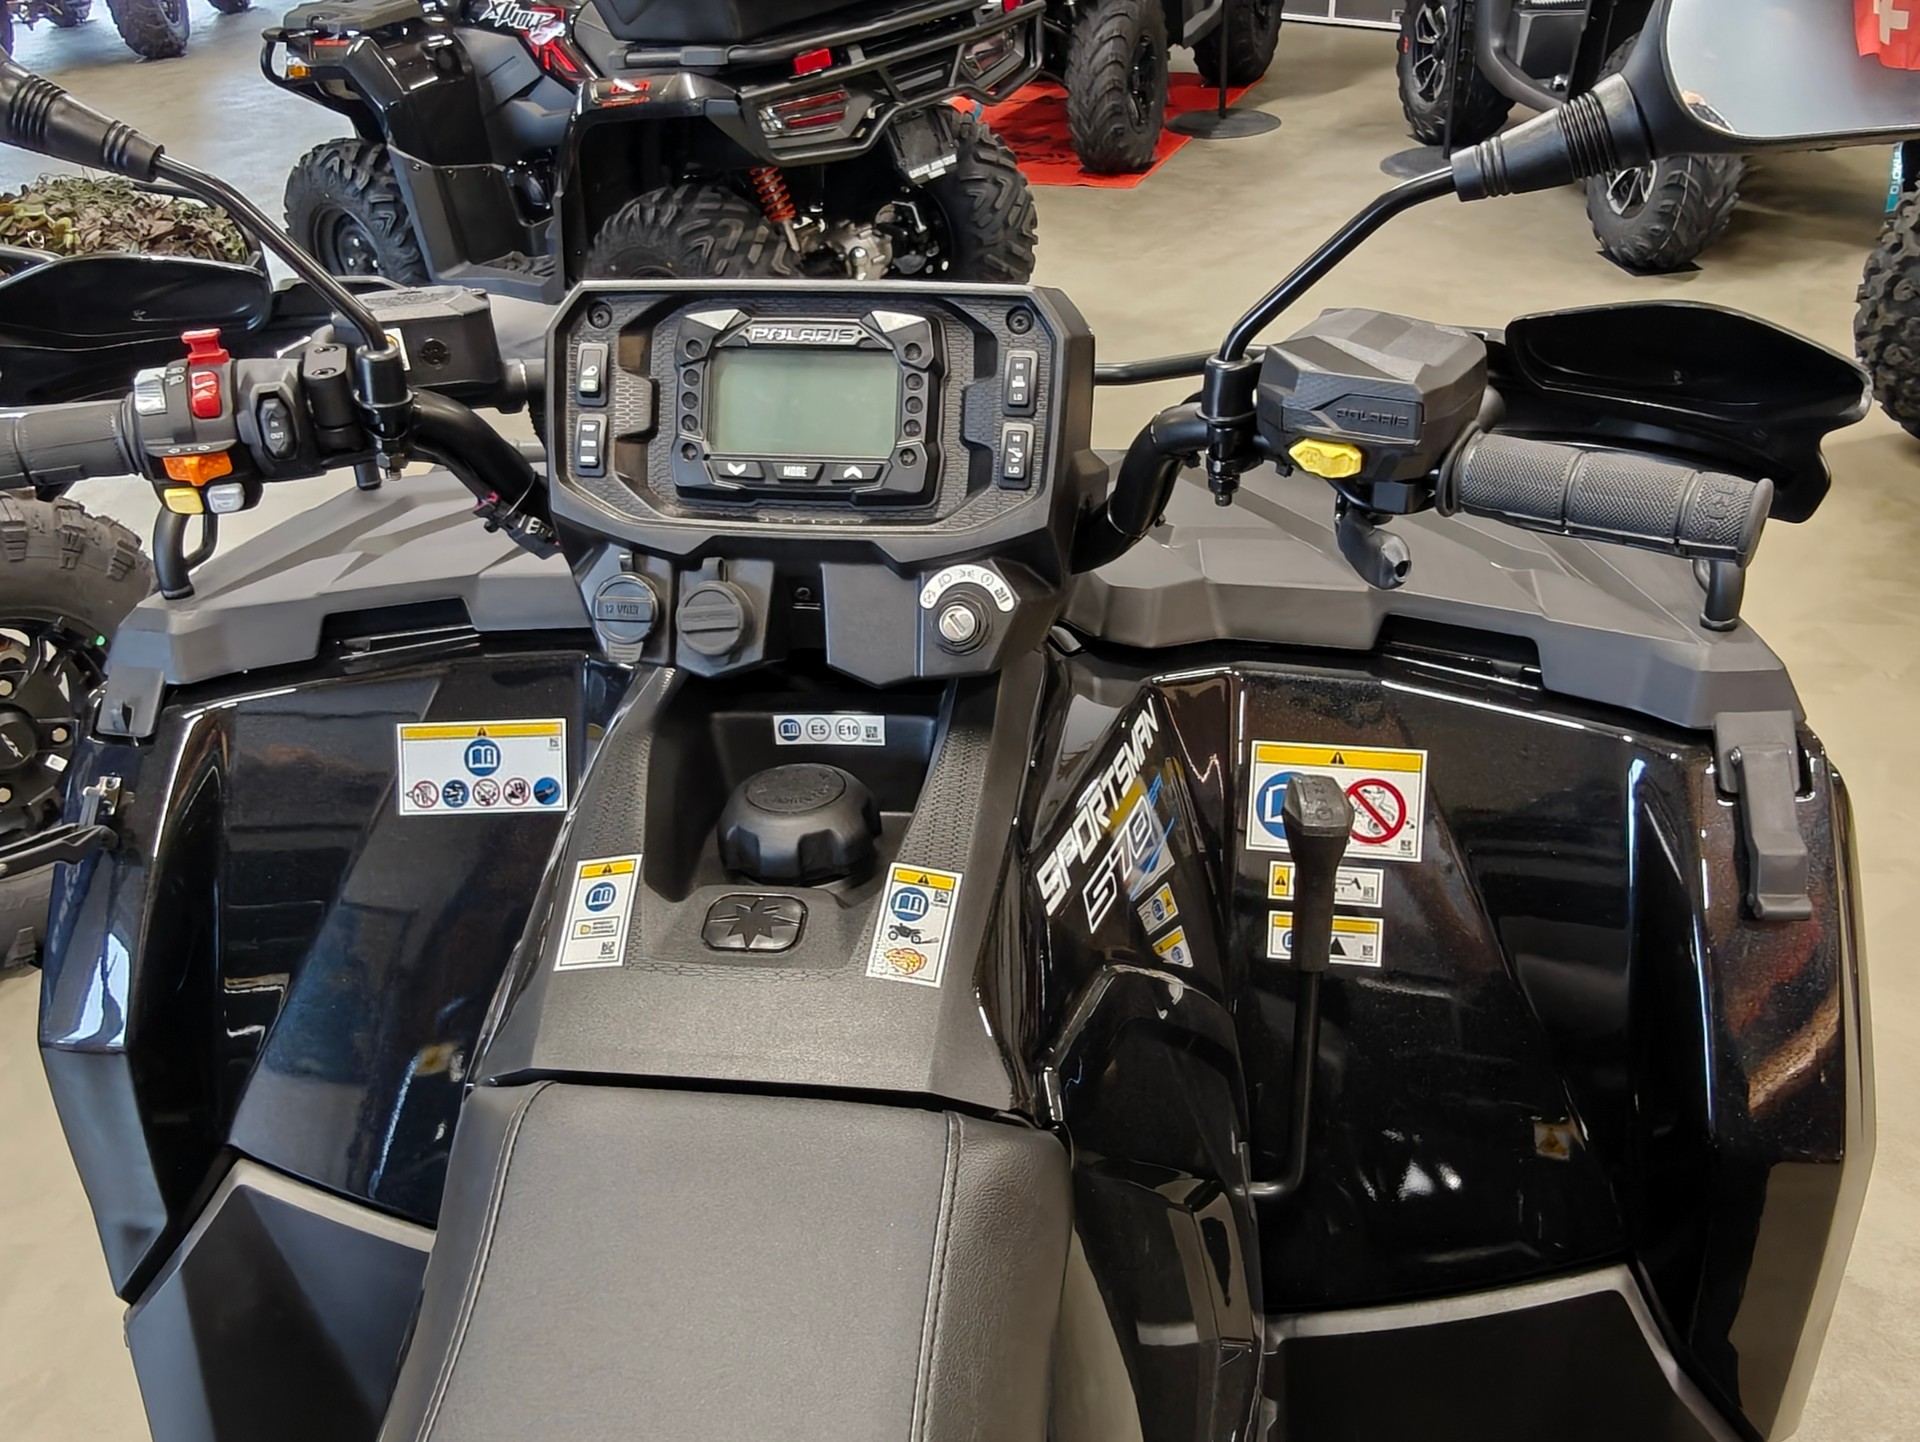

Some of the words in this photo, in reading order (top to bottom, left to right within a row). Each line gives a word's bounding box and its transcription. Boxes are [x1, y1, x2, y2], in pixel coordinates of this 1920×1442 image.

[750, 327, 856, 343] POLARIS
[1013, 393, 1023, 401] LO
[1336, 407, 1409, 427] POLARIS
[270, 432, 284, 440] OUT
[783, 465, 808, 478] MODE
[1008, 466, 1020, 474] LO
[605, 604, 615, 615] 12
[811, 724, 826, 735] E5
[838, 725, 858, 735] E10
[1036, 695, 1159, 917] SPORTSMAN
[1082, 794, 1153, 935] 570
